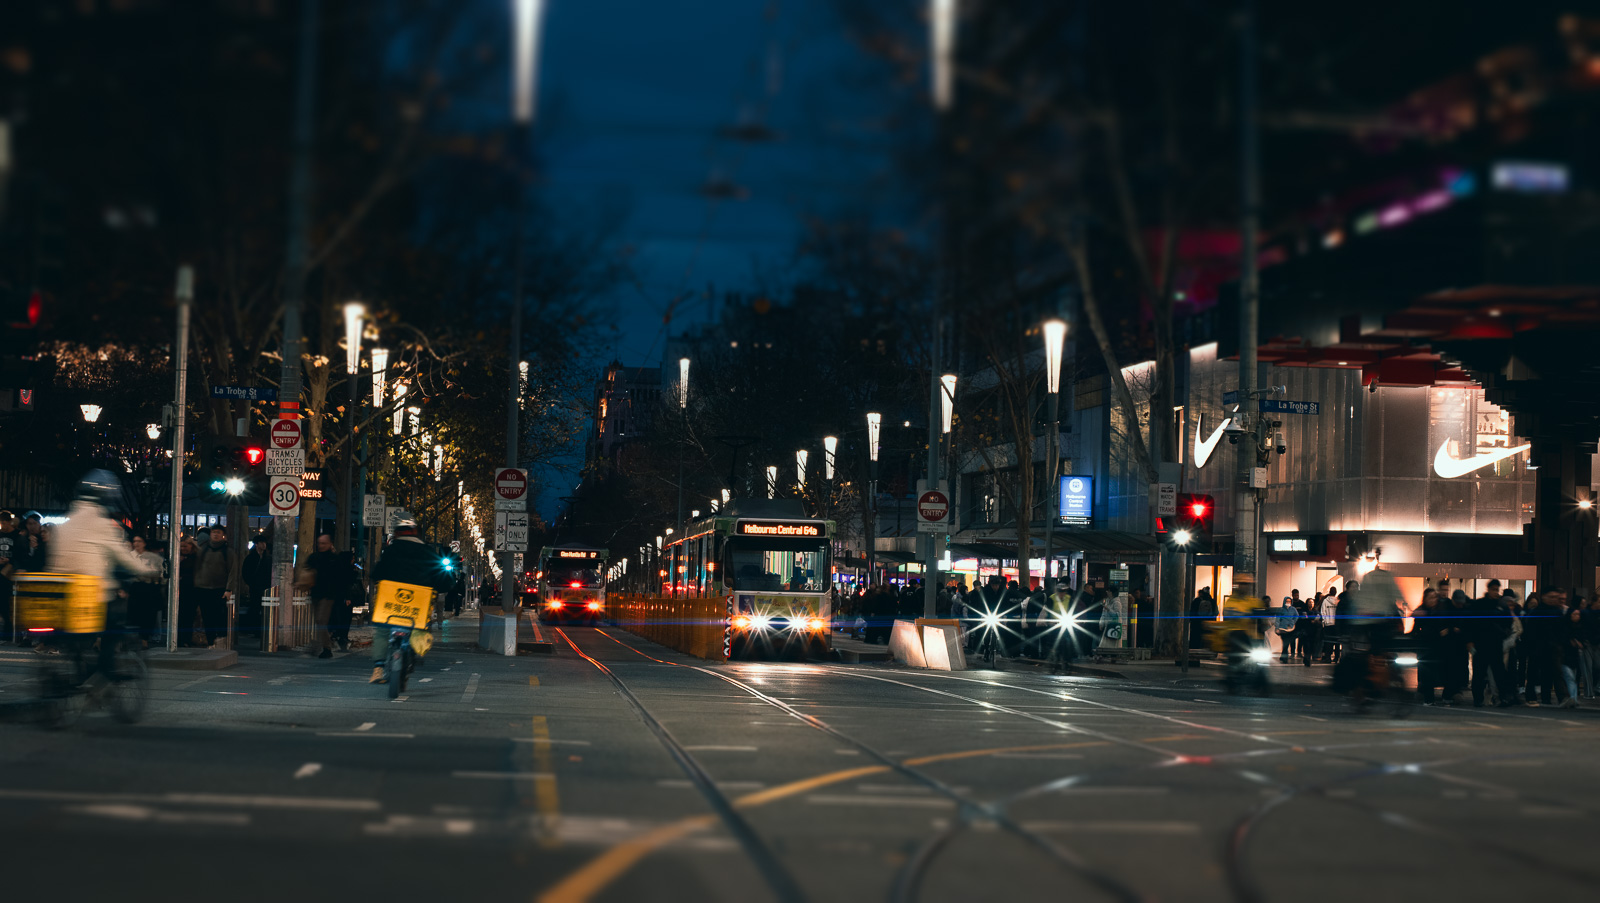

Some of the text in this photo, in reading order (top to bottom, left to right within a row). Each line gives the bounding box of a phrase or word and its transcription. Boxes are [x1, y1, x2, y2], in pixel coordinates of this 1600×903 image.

[214, 386, 257, 396] La Trobe St
[1289, 402, 1308, 410] Trobe
[1310, 403, 1318, 411] St
[271, 450, 295, 458] TRAMS
[268, 458, 303, 466] BICYCLES
[267, 466, 304, 474] EXCEPTED
[302, 472, 321, 481] WAY
[275, 489, 295, 503] 30
[299, 490, 322, 498] NGERS
[744, 524, 818, 535] Melbourne Central 64a
[508, 531, 526, 539] ONLY
[804, 582, 823, 591] 2121
